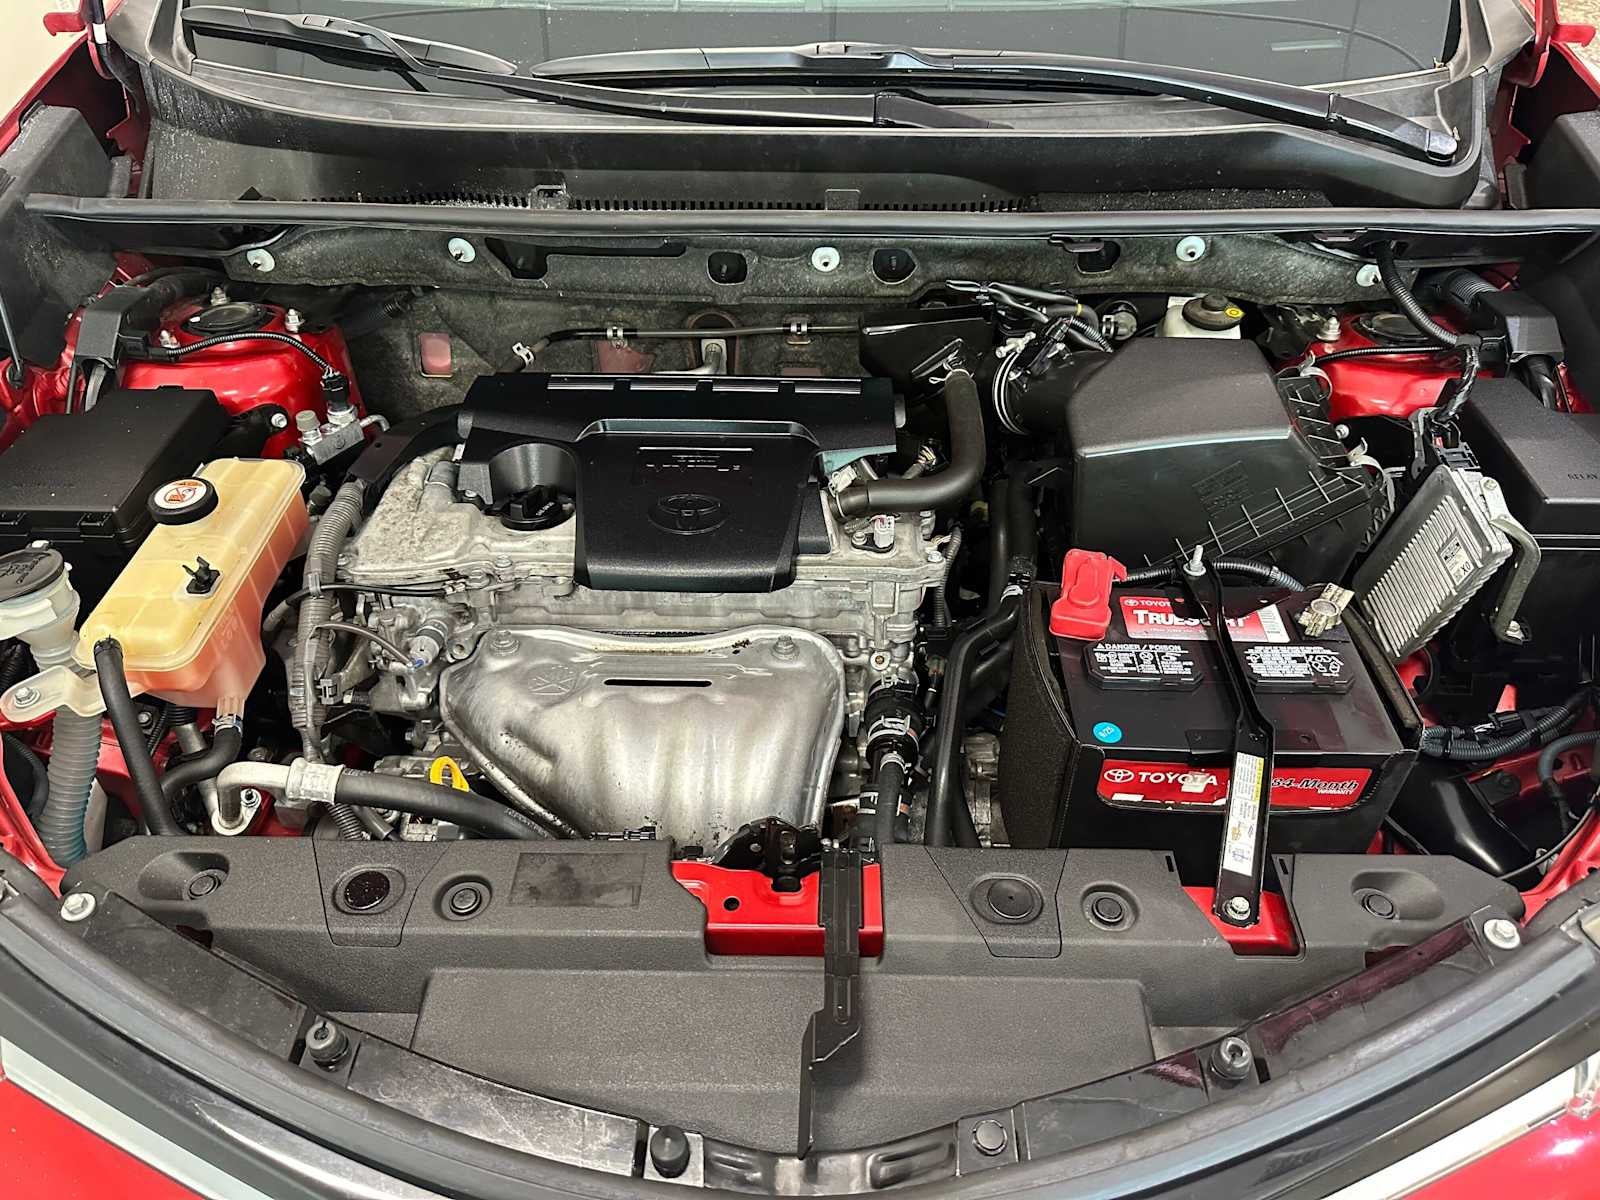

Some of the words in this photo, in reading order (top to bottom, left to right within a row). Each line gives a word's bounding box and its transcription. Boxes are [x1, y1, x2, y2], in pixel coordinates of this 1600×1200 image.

[1105, 643, 1140, 651] DANGER
[1149, 644, 1182, 652] POISON
[1138, 771, 1217, 786] TOYOTA
